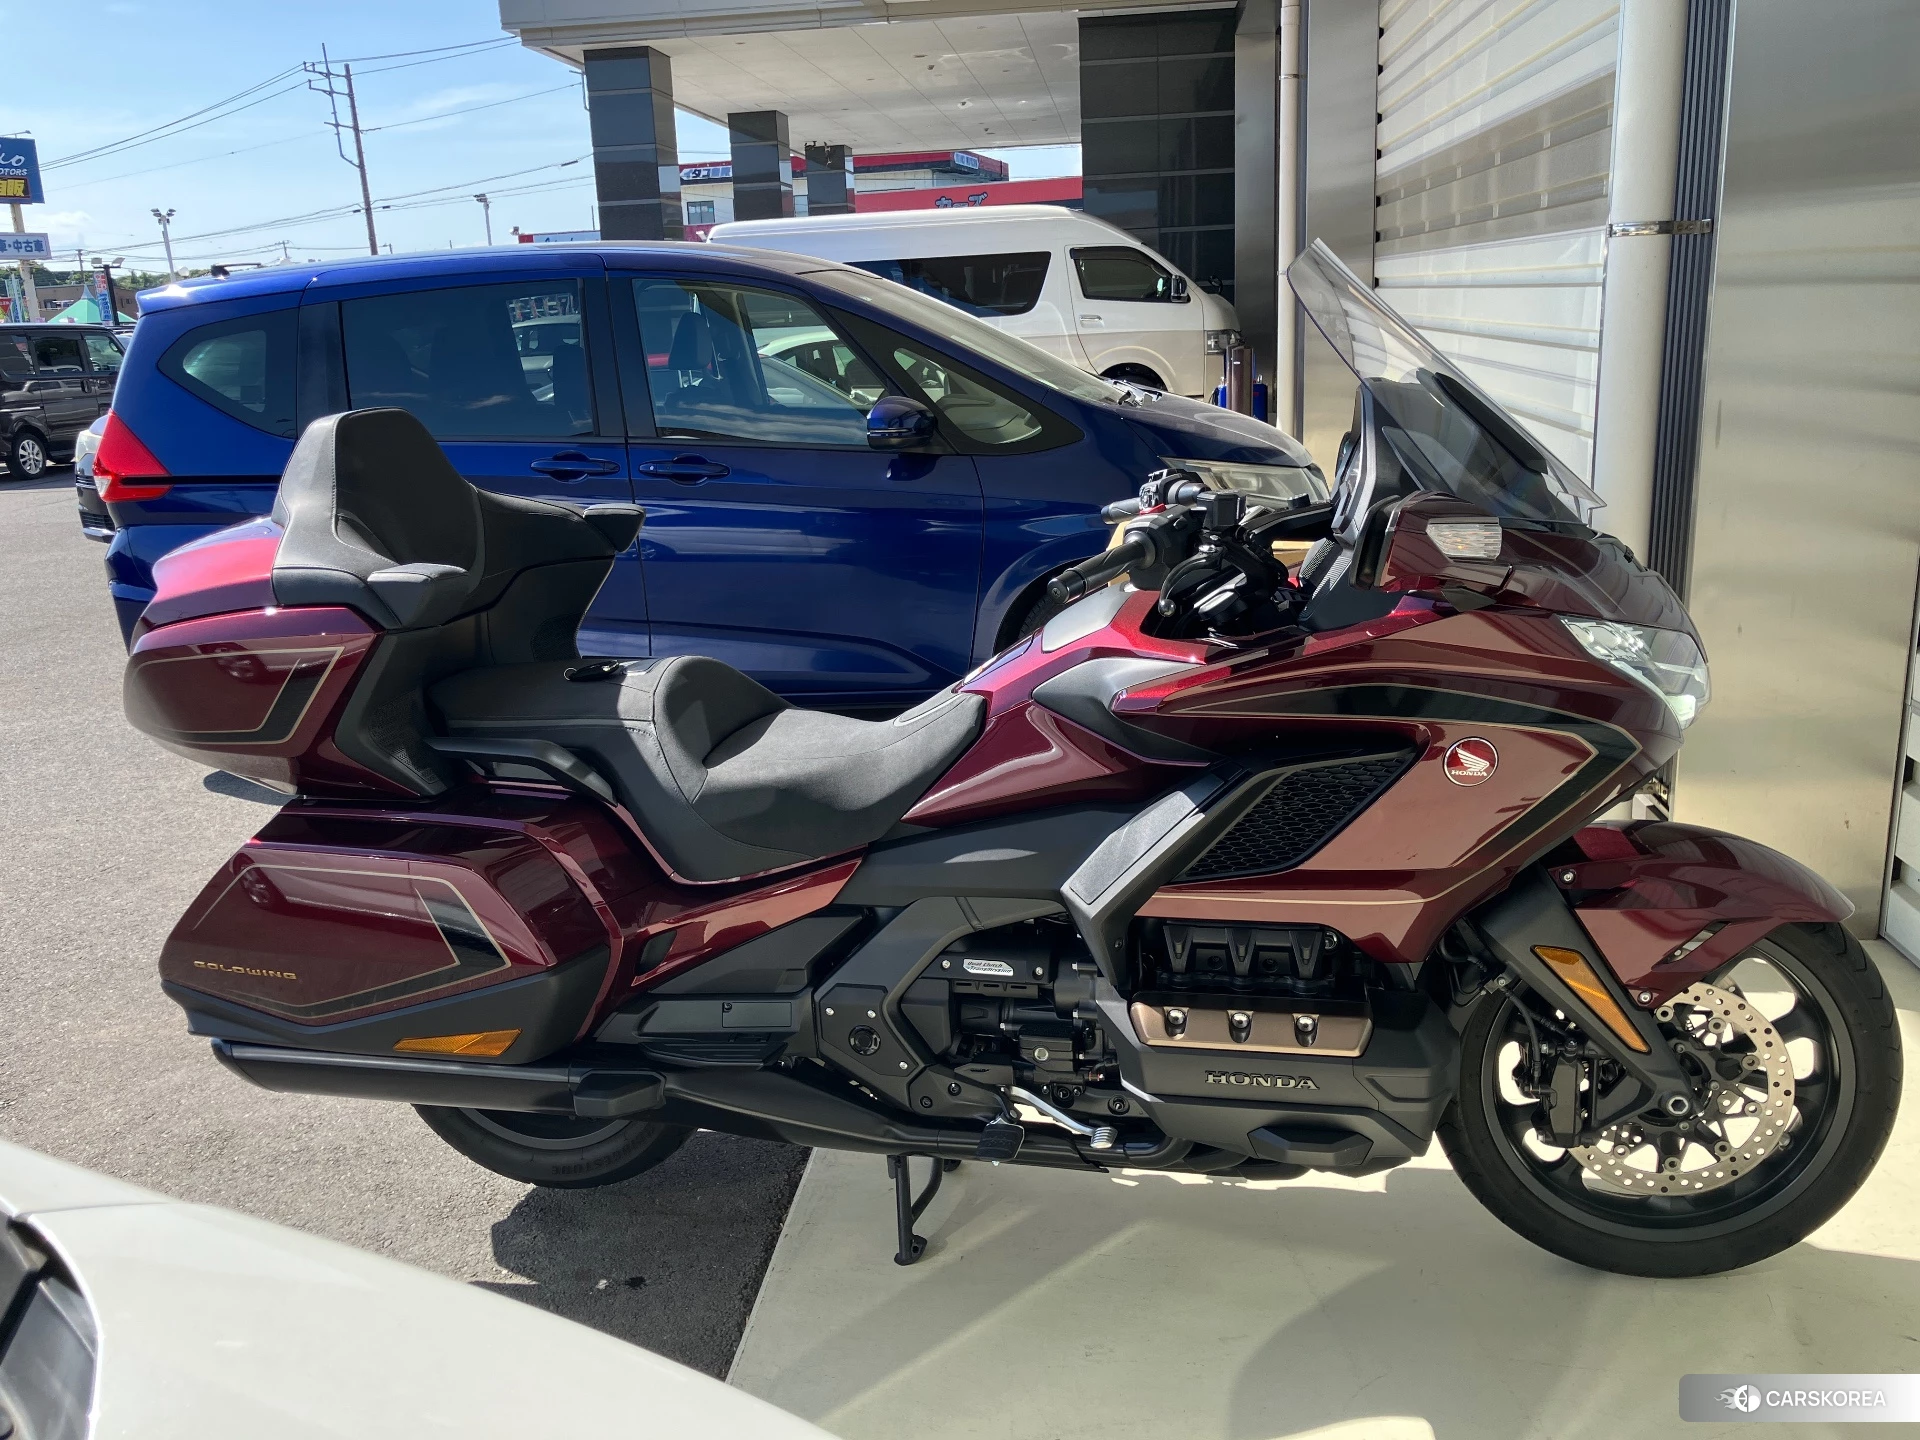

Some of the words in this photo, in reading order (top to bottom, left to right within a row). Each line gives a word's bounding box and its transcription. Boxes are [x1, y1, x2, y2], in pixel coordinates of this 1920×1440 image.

[1451, 769, 1488, 777] HONDA
[193, 960, 297, 980] GOLDWING
[1204, 1070, 1320, 1090] HONDA
